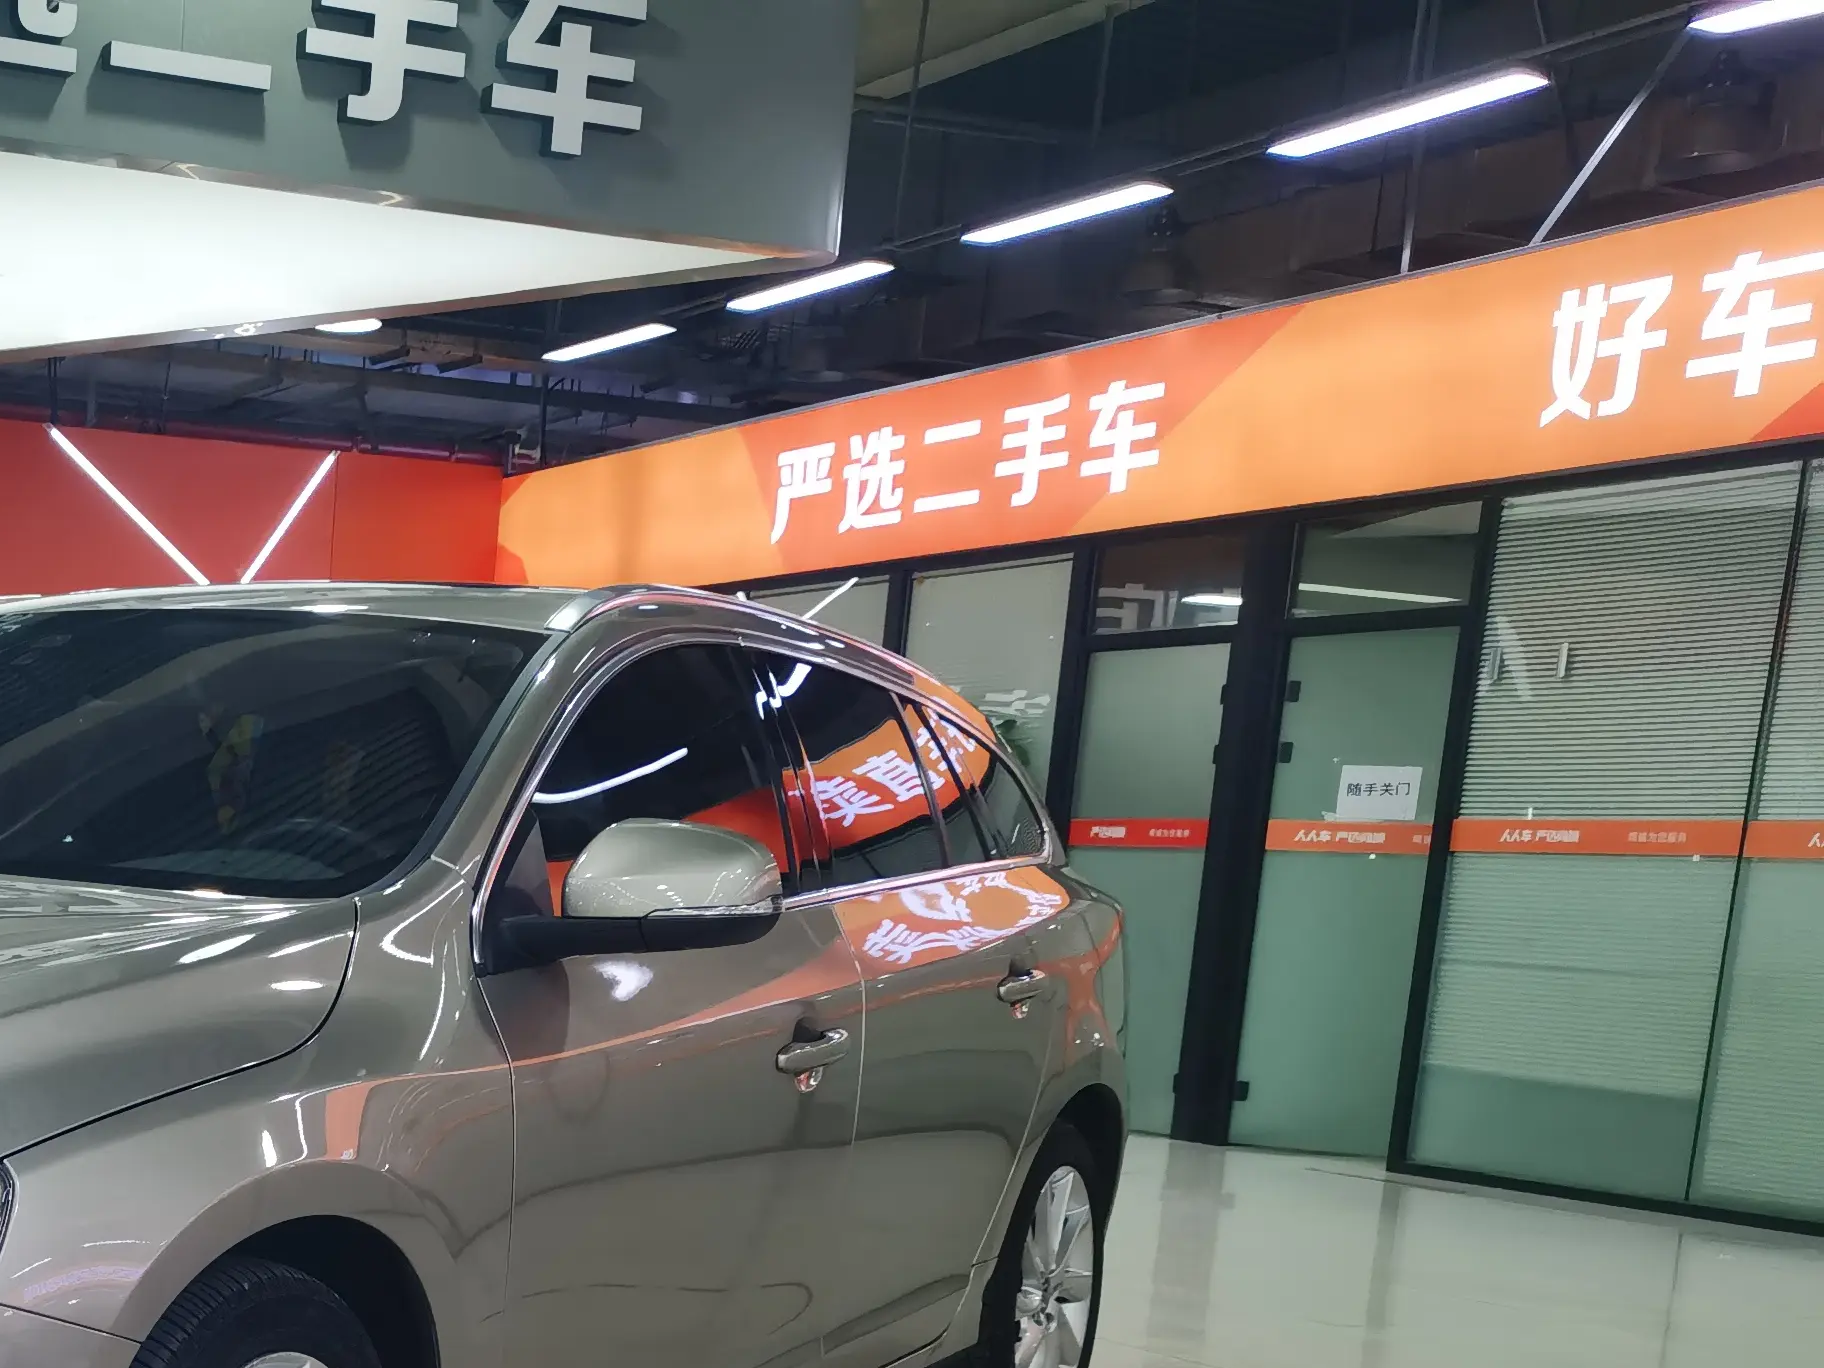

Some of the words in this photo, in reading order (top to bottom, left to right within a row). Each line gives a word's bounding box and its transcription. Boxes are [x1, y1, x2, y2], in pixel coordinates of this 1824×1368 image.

[1540, 251, 1824, 427] 好车
[770, 379, 1167, 544] 严选二手车
[1346, 782, 1411, 796] 随手关门
